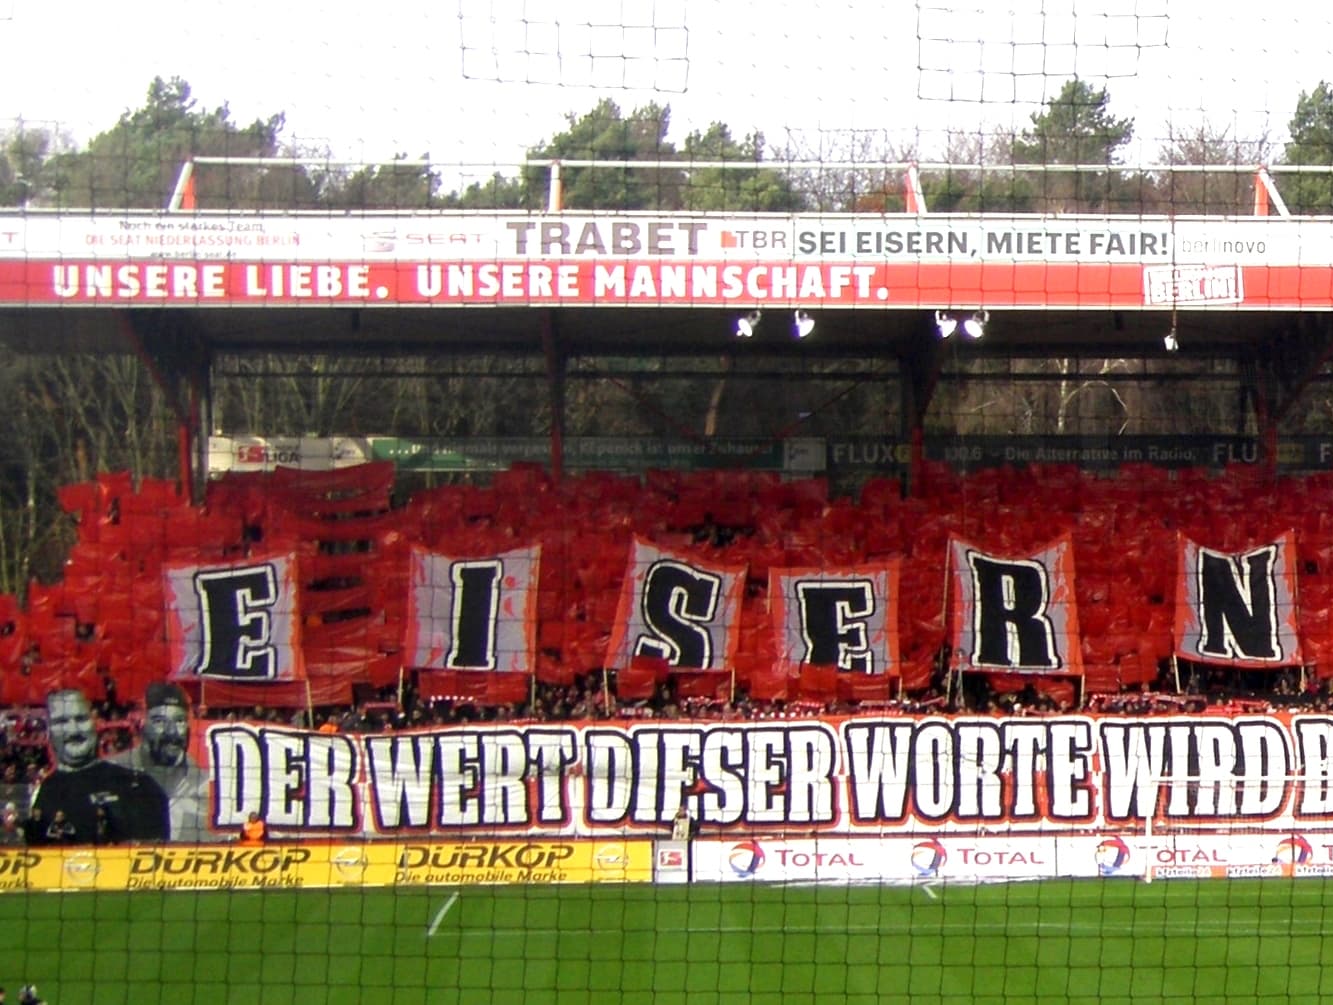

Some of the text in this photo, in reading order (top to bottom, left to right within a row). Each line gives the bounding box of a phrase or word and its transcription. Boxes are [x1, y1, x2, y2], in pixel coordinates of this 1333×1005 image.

[145, 234, 252, 245] NIEDERLASSUNG
[256, 234, 300, 246] BERLIN
[406, 233, 483, 245] SEAT
[506, 222, 708, 256] TRABET
[735, 230, 787, 249] TBR
[799, 231, 1168, 257] SEI EISERN, MIETE FAIR!
[1182, 238, 1266, 254] berlinovo
[52, 265, 889, 300] UNSERE LIEBE. UNSERE MANNSCHAFT.
[210, 727, 360, 831] DER
[367, 729, 576, 831] WERT
[586, 725, 836, 826] DIESER
[846, 721, 1094, 823] WORTE
[1101, 719, 1292, 819] WIRD
[775, 849, 864, 867] TOTAL
[957, 848, 1045, 865] TOTAL
[128, 873, 304, 889] Die automobile Marke
[394, 869, 568, 883] Die automobile Marke
